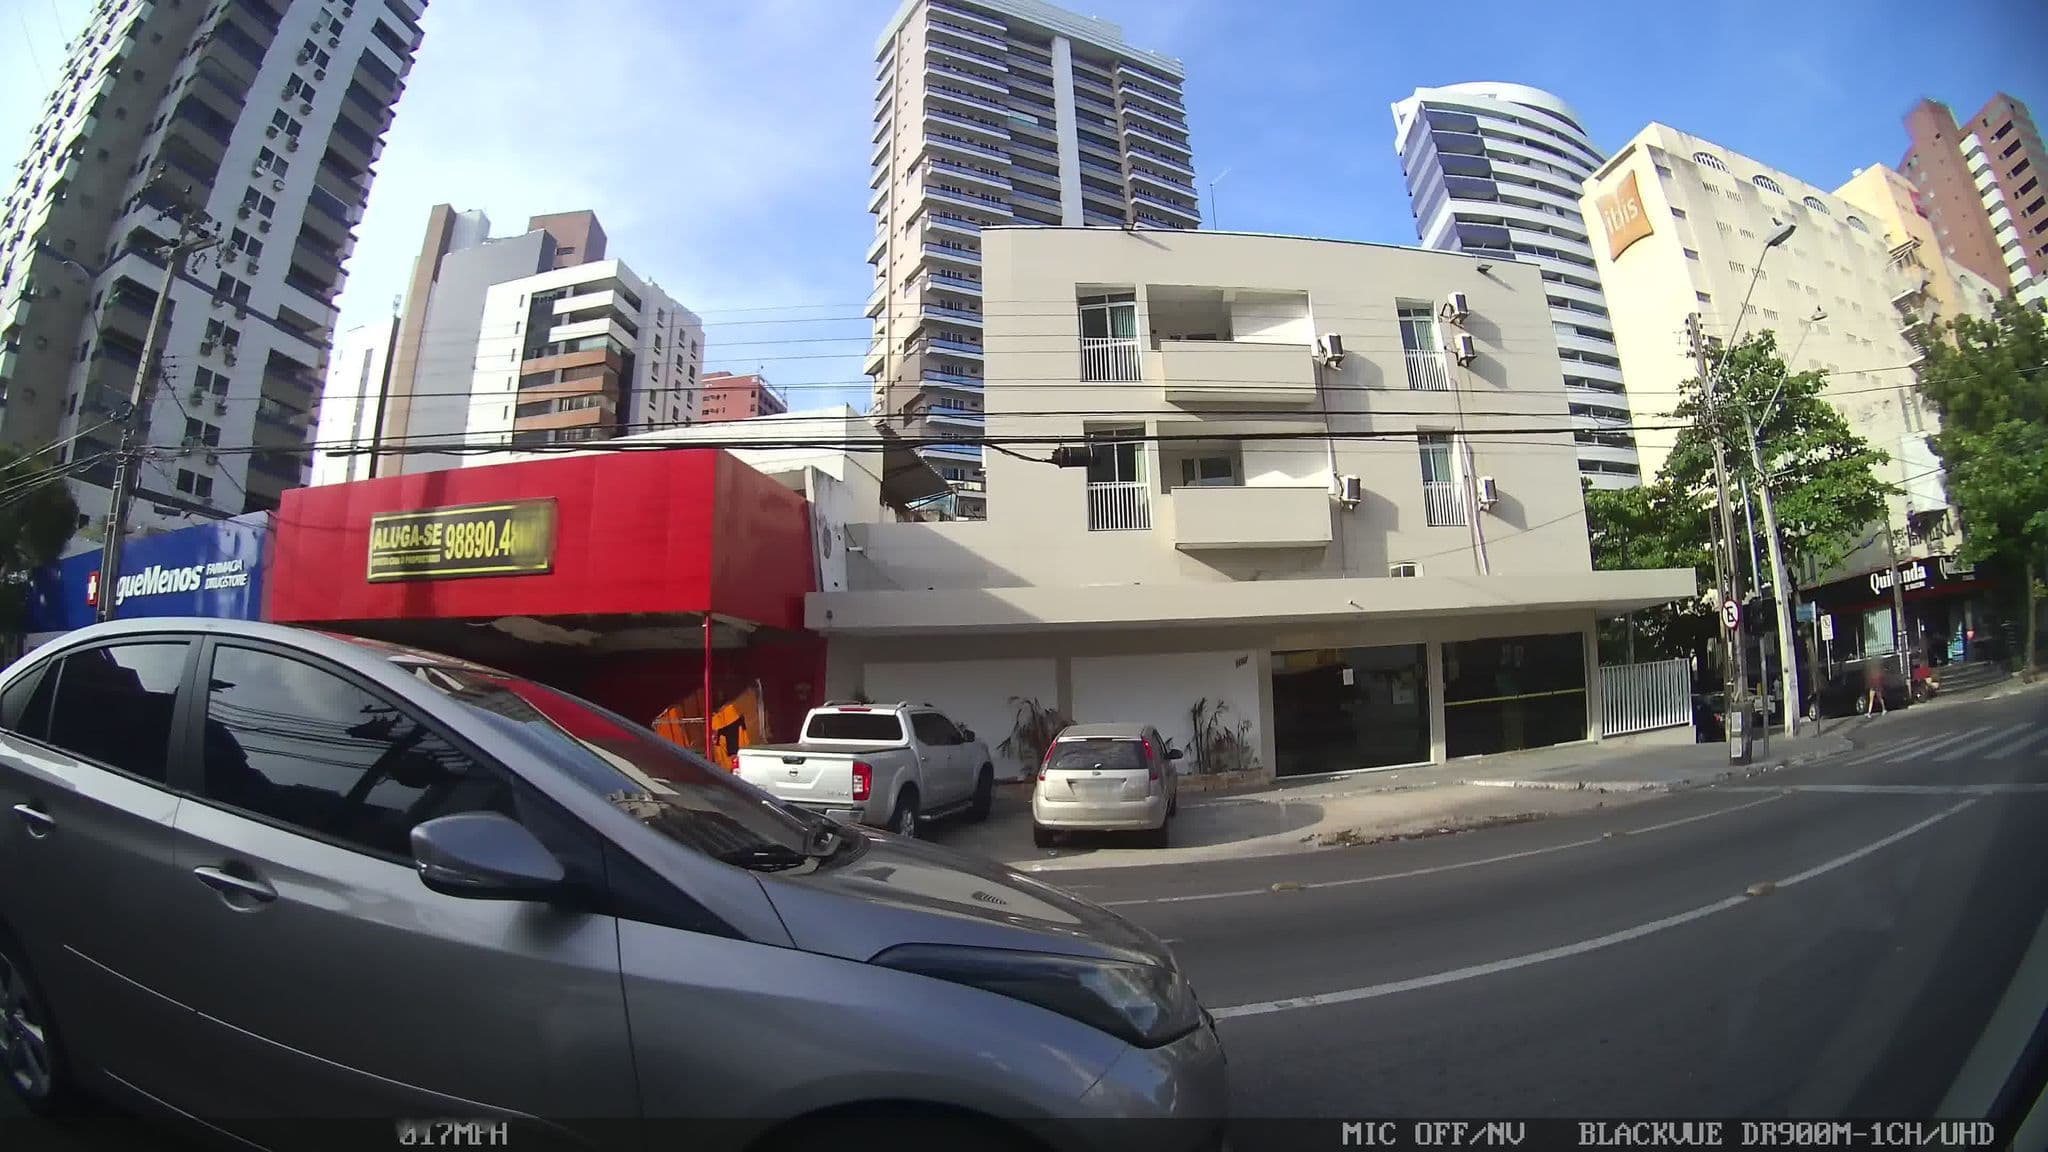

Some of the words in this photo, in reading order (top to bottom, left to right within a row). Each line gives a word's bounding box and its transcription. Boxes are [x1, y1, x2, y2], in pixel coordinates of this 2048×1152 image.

[1604, 198, 1639, 233] ibis
[374, 523, 444, 550] ALUGA-SE
[116, 565, 203, 605] gueMenos
